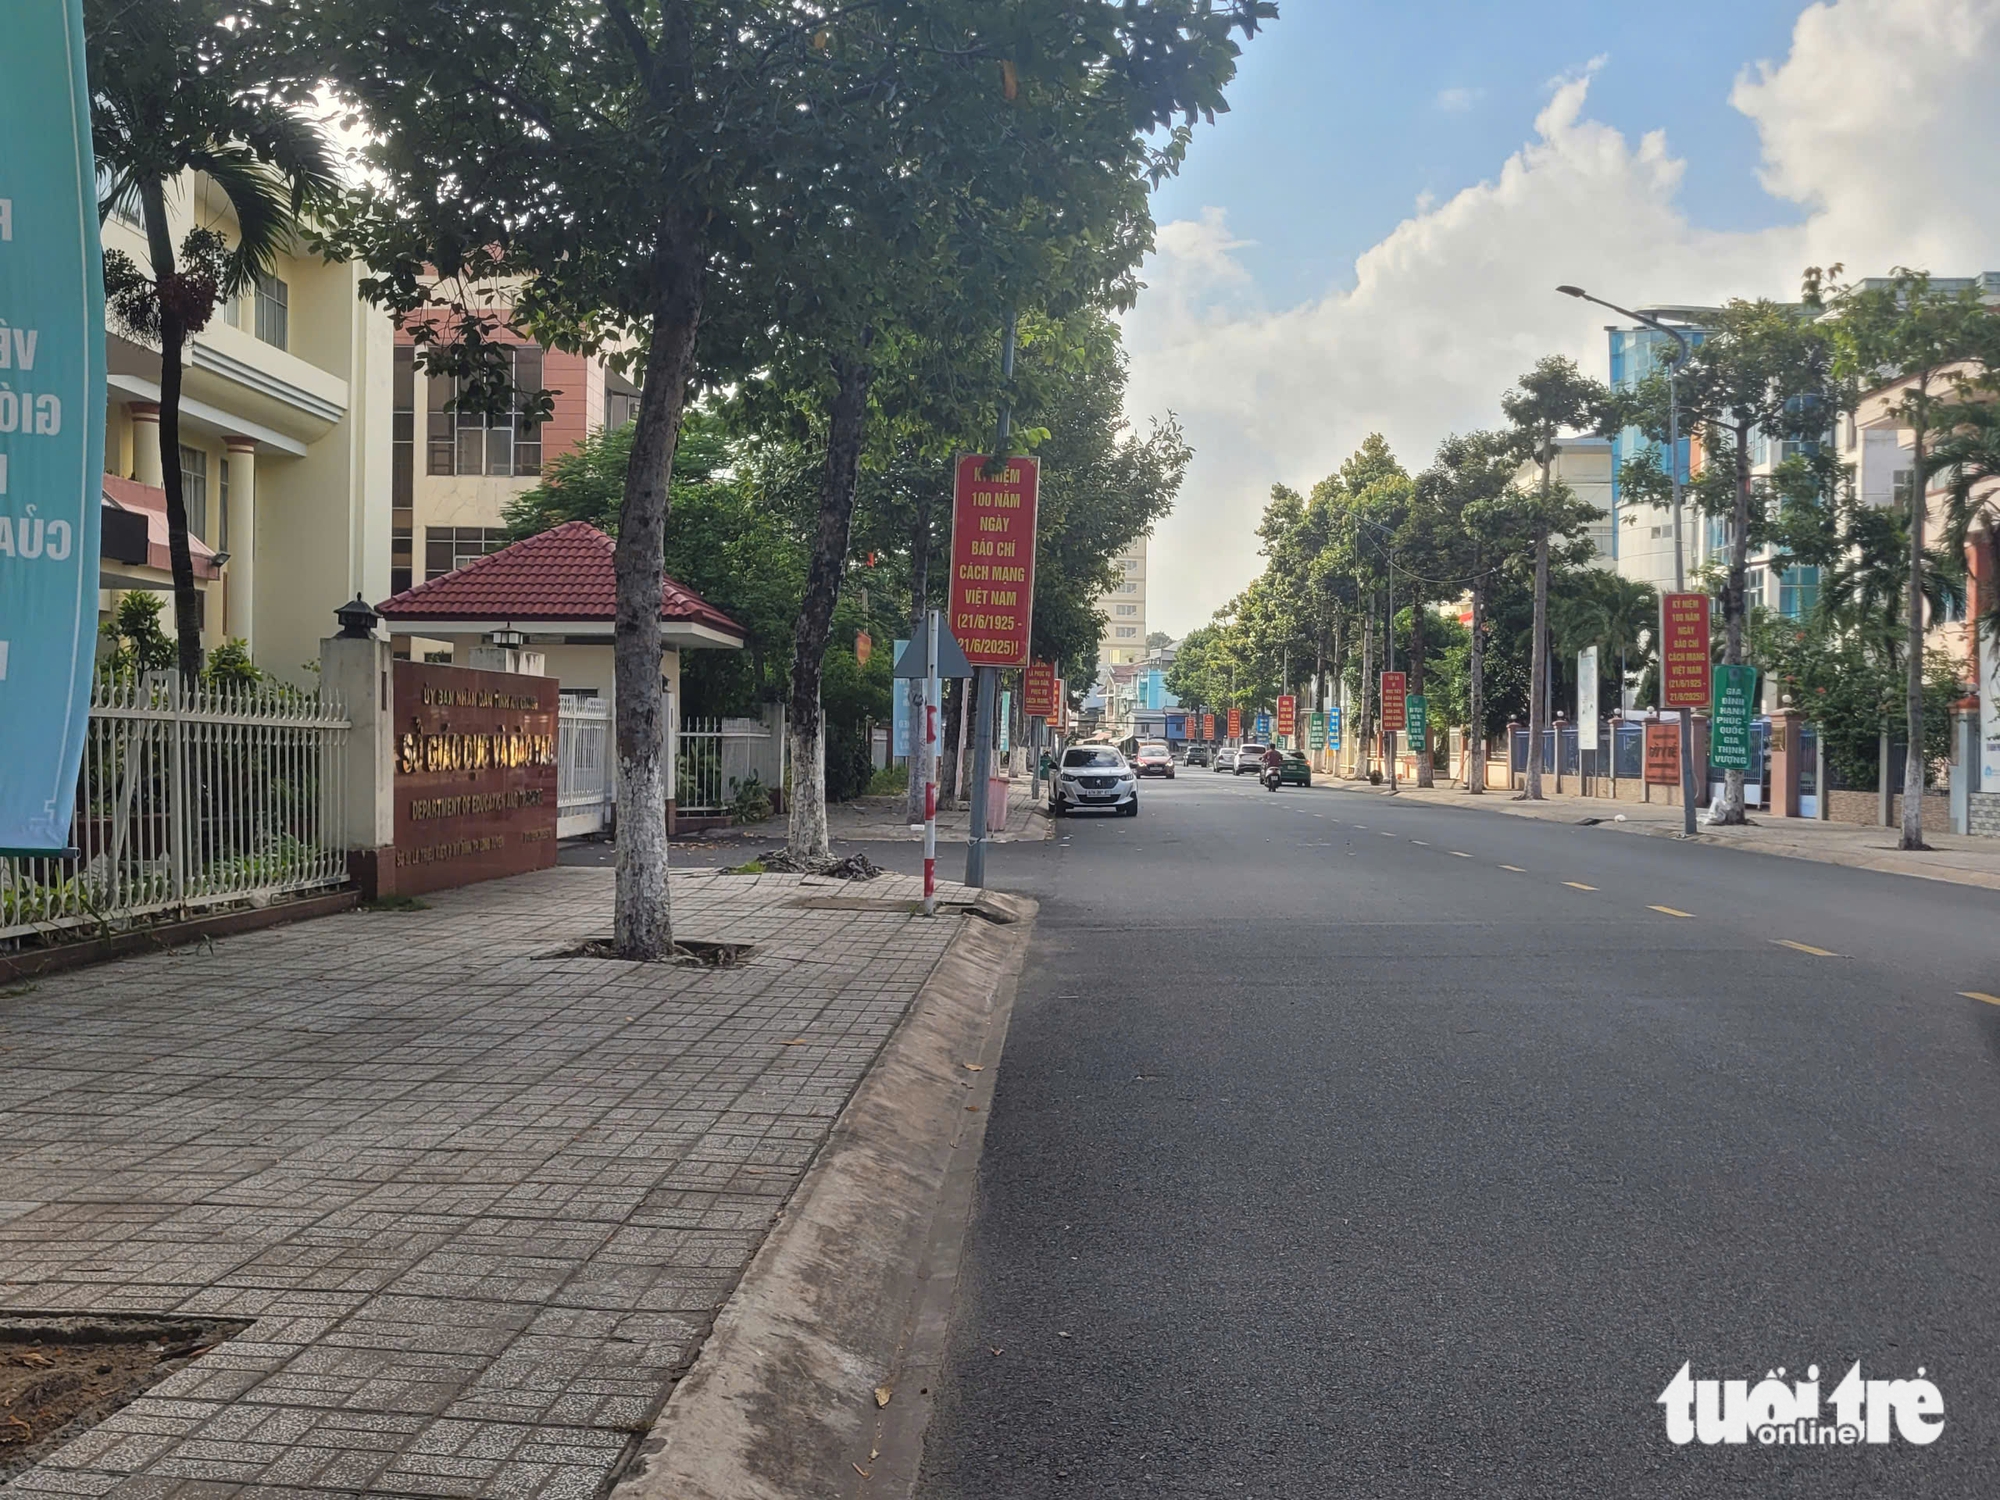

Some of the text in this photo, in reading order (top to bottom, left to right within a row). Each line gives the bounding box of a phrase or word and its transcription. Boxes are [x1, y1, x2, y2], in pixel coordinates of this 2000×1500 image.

[974, 467, 987, 482] K
[972, 489, 1021, 509] 100 NĂM
[979, 513, 1010, 532] NGÀY
[971, 538, 1016, 557] BÁO CHÍ
[959, 562, 1026, 585] CÁCH MẠNG
[965, 586, 1017, 608] VIỆT NAM
[957, 612, 1015, 631] (21/6/1925
[1687, 665, 1703, 675] NAM
[1726, 687, 1742, 696] GIA
[1721, 695, 1745, 706] ĐÌNH
[1719, 707, 1746, 717] HẠNH
[1716, 714, 1742, 725] PHÚC
[1719, 723, 1745, 735] QUỐC
[1723, 736, 1739, 745] GIA
[1717, 745, 1746, 756] THỊNH
[1714, 755, 1748, 765] VƯỢNG
[411, 796, 461, 821] DEPARTMENT
